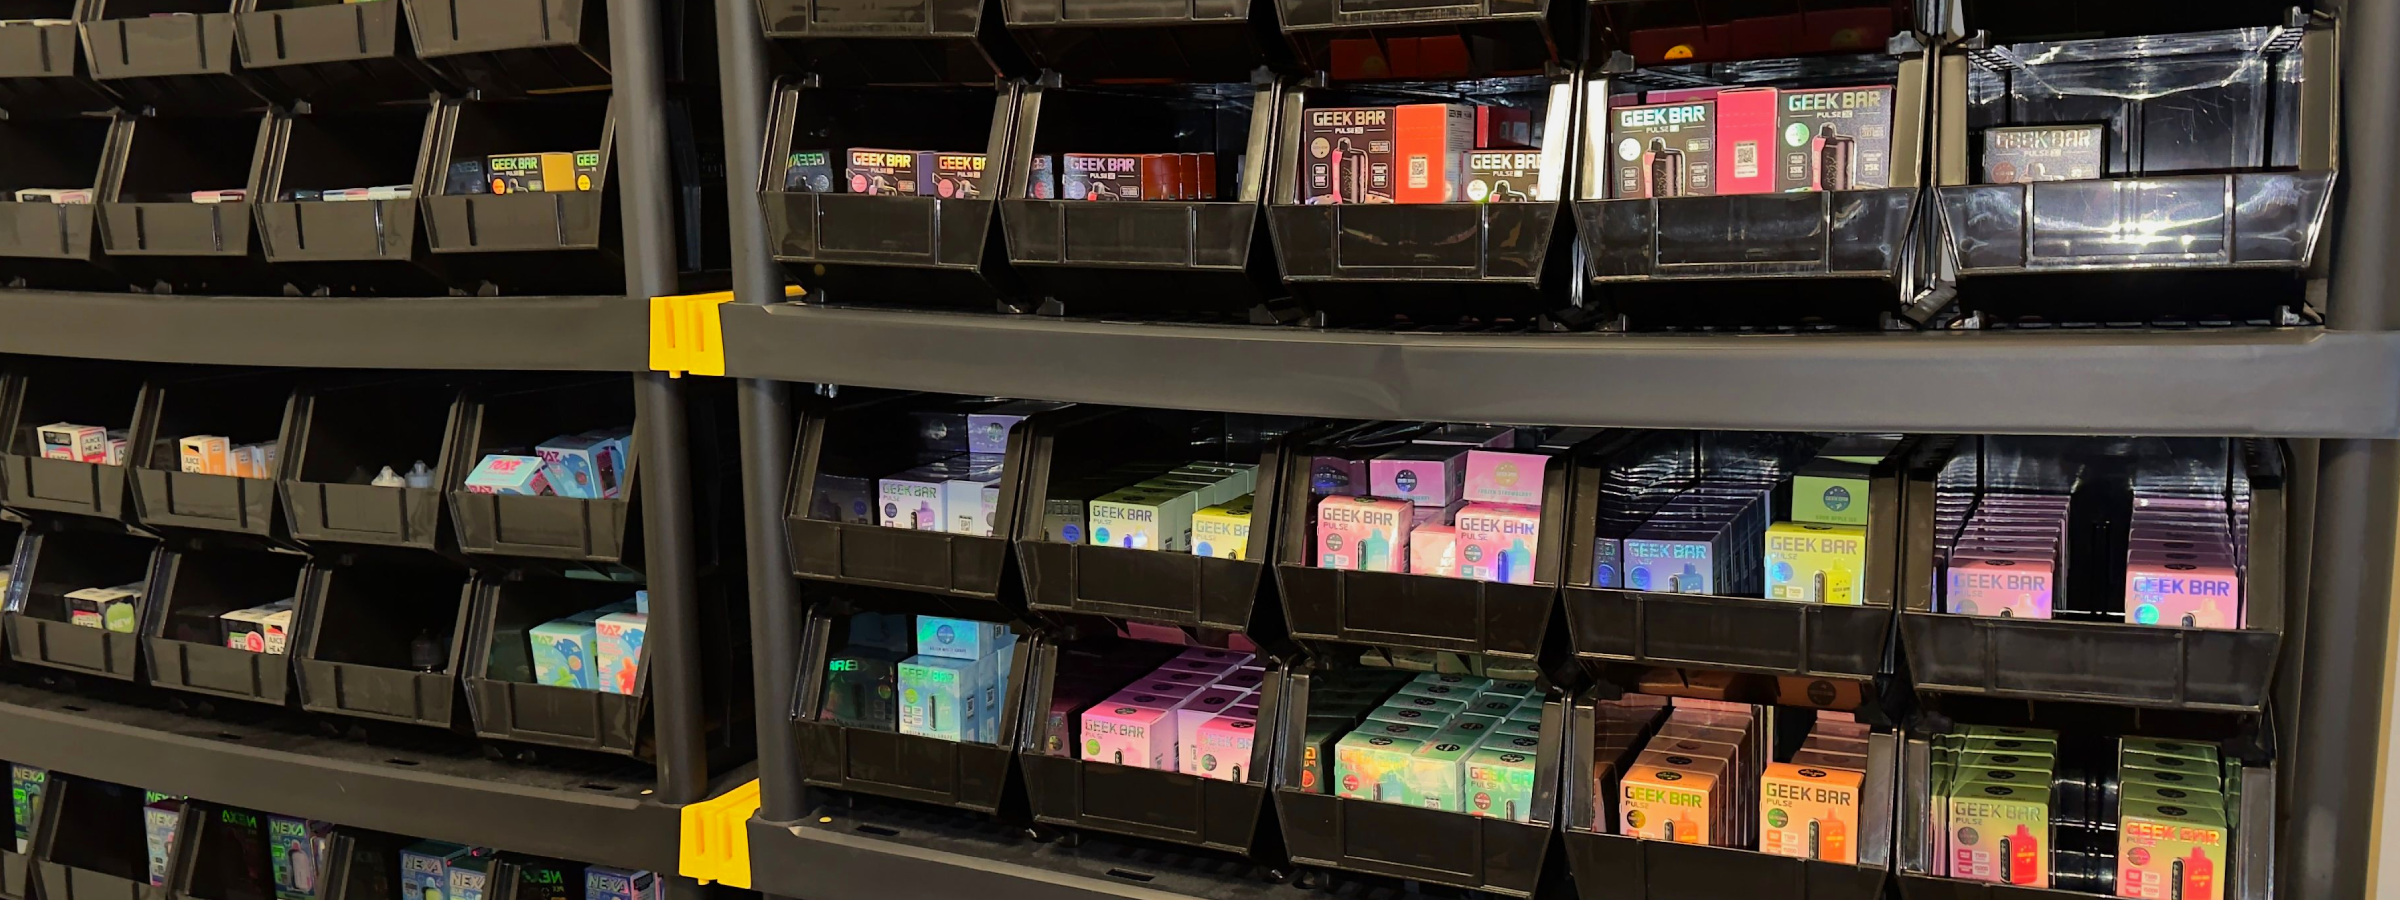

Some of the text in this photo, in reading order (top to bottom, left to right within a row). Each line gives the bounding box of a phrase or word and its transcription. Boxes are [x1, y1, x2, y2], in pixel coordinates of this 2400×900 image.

[1789, 91, 1881, 111] GEEK BAR
[1313, 110, 1386, 126] GEEK BAR
[1621, 106, 1706, 127] GEEK BAR
[1995, 129, 2091, 149] GEEK BAR
[492, 157, 518, 170] GEEK
[518, 157, 538, 170] BAR
[853, 152, 911, 168] GEEK BAR
[939, 156, 972, 170] GEEK
[1071, 158, 1135, 172] GEEK BAR
[1471, 154, 1512, 169] GEEK
[185, 457, 199, 465] JUICE
[883, 482, 937, 499] GEEK BAR
[1093, 505, 1125, 520] GEEK
[1128, 508, 1152, 522] BAR
[1323, 507, 1393, 526] GEEK BAR
[1196, 520, 1232, 535] GEEK
[1323, 522, 1348, 531] PULSE
[1460, 517, 1534, 535] GEEK BAR
[1461, 532, 1488, 541] PULSE
[1770, 535, 1857, 555] GEEK BAR
[1629, 542, 1671, 558] GEEK
[1673, 544, 1706, 559] BAR
[1954, 572, 2045, 591] GEEK BAR
[2133, 576, 2230, 597] GEEK BAR
[110, 616, 132, 628] NEW
[598, 624, 621, 636] RAZ
[269, 636, 283, 644] JUICE
[1085, 719, 1144, 739] GEEK BAR
[13, 767, 45, 782] NEXA
[1470, 766, 1507, 783] GEEK
[1625, 786, 1702, 808] GEEK BAR
[1766, 782, 1850, 806] GEEK BAR
[1625, 800, 1649, 809] PULSE
[1767, 798, 1793, 808] PULSE
[1955, 801, 2040, 822] GEEK BAR
[270, 821, 306, 837] NEXA
[1955, 817, 1983, 826] PULSE
[2126, 821, 2220, 847] GEEK BAR
[403, 854, 444, 877] NEXA
[587, 873, 630, 894] NEXA
